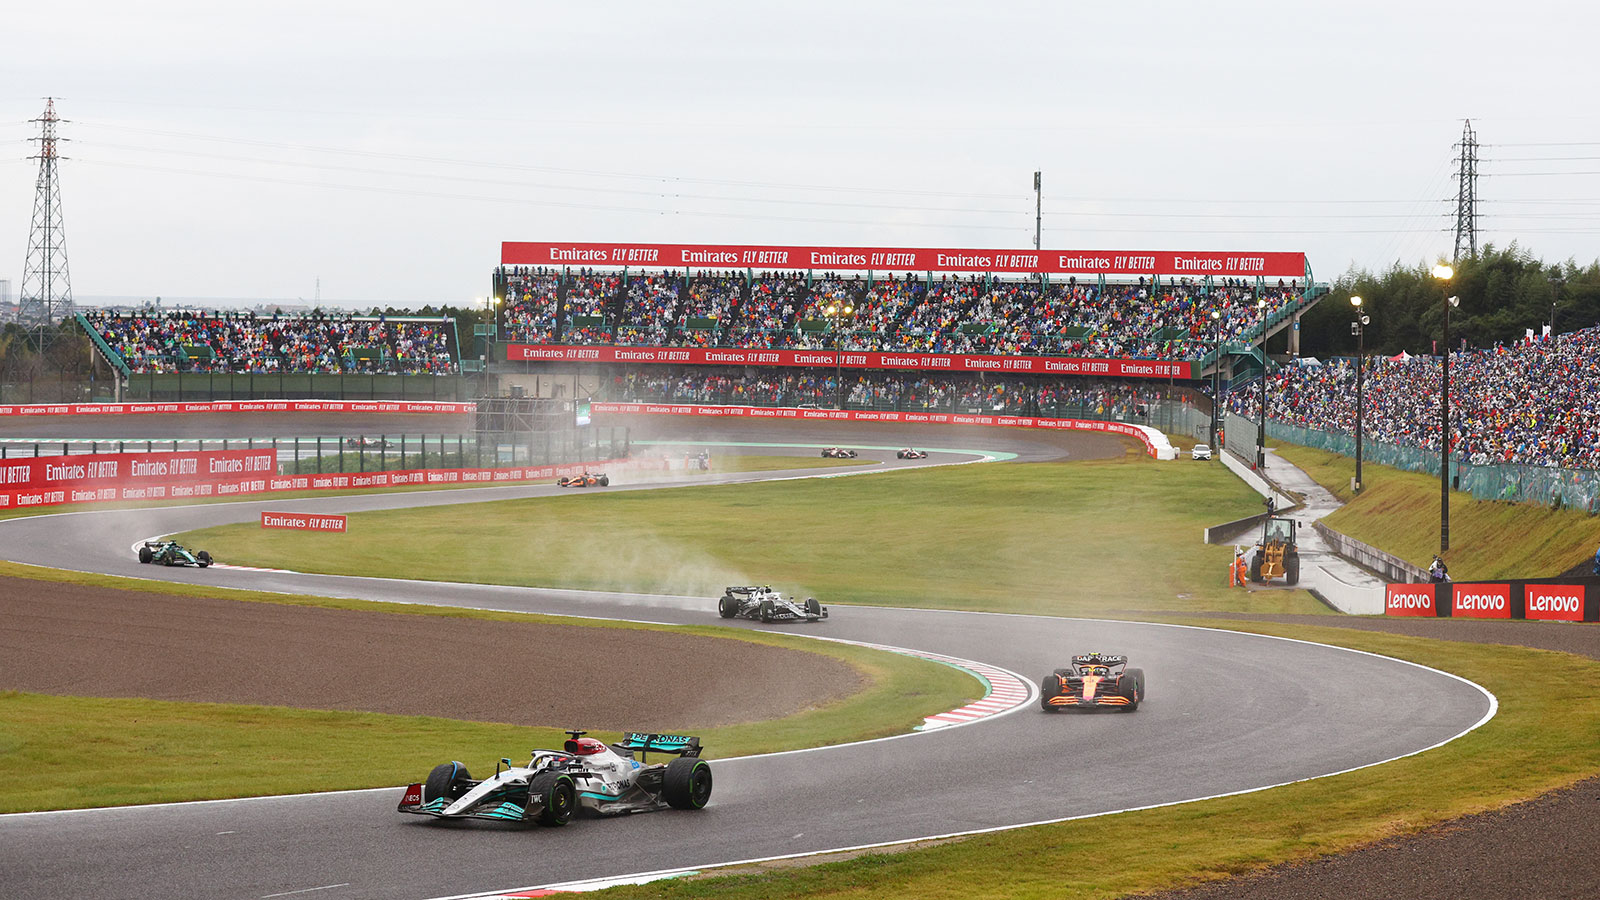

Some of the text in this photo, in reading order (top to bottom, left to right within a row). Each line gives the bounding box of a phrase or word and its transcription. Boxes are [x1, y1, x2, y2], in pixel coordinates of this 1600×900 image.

[550, 248, 658, 261] Emirates FLY BETTER
[682, 250, 788, 263] Emirates FLY BETTER
[811, 252, 915, 265] Emirates FLY BETTER
[938, 254, 1038, 267] Emirates FLY BETTER
[1059, 256, 1155, 269] Emirates FLY BETTER
[1175, 257, 1264, 270] Emirates FLY BETTER
[524, 349, 599, 358] Emirates FLY BETTER
[615, 351, 689, 360] Emirates FLY BETTER
[706, 352, 779, 362] Emirates FLY BETTER
[795, 354, 832, 363] Emirates
[847, 356, 866, 364] BETTER
[881, 357, 950, 367] Emirates FLY BETTER
[965, 359, 1031, 369] Emirates FLY BETTER
[1045, 361, 1108, 372] Emirates FLY BETTER
[1121, 364, 1153, 374] Emirates
[46, 461, 117, 480] Emirates FLY BETTER
[132, 459, 197, 476] Emirates FLY BETTER
[210, 456, 271, 473] Emirates FLY BETTER
[8, 466, 30, 483] BETTER
[241, 482, 249, 491] FLY
[18, 494, 42, 505] Emirates
[264, 516, 343, 528] Emirates FLY BETTER
[1388, 591, 1430, 608] Lenovo
[1457, 591, 1504, 609] Lenovo
[1530, 592, 1579, 611] Lenovo
[531, 794, 542, 803] IWC
